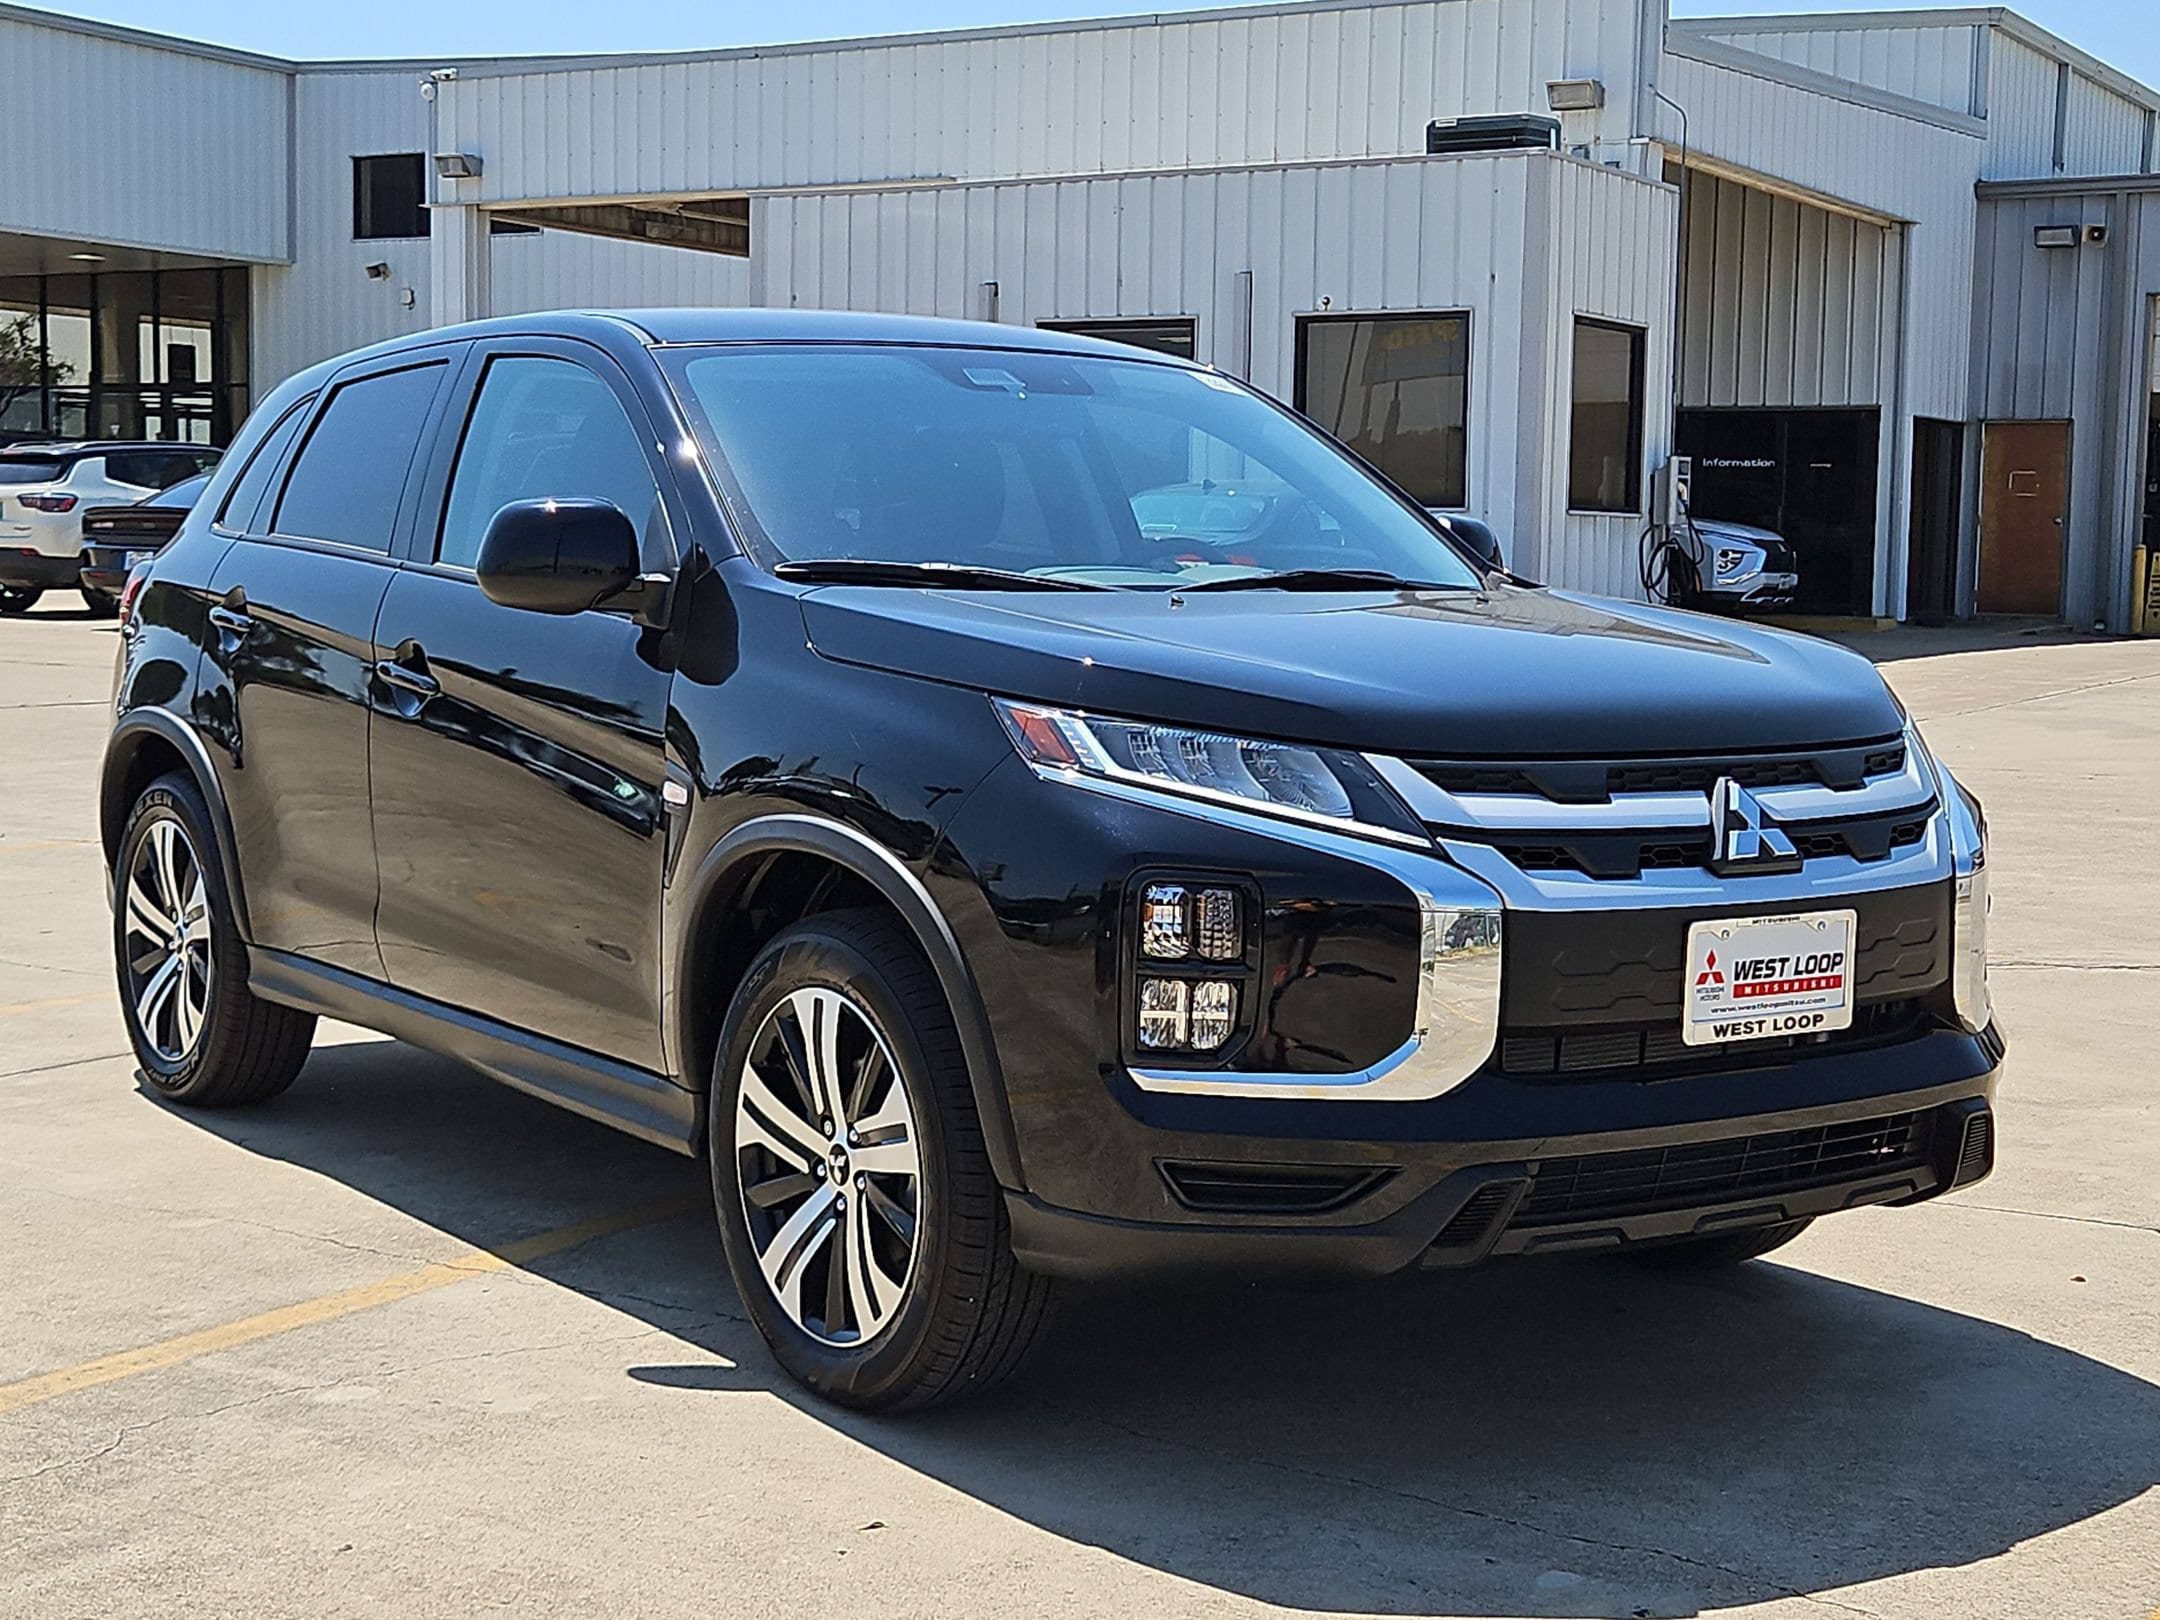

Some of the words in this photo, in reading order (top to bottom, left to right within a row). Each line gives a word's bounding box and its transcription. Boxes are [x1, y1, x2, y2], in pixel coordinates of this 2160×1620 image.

[1702, 457, 1776, 468] Information
[1733, 957, 1790, 982] WEST
[1794, 952, 1844, 976] LOOP
[1743, 978, 1835, 996] MITSUBISHI
[1713, 1019, 1767, 1039] WEST
[1773, 1014, 1825, 1032] LOOP
